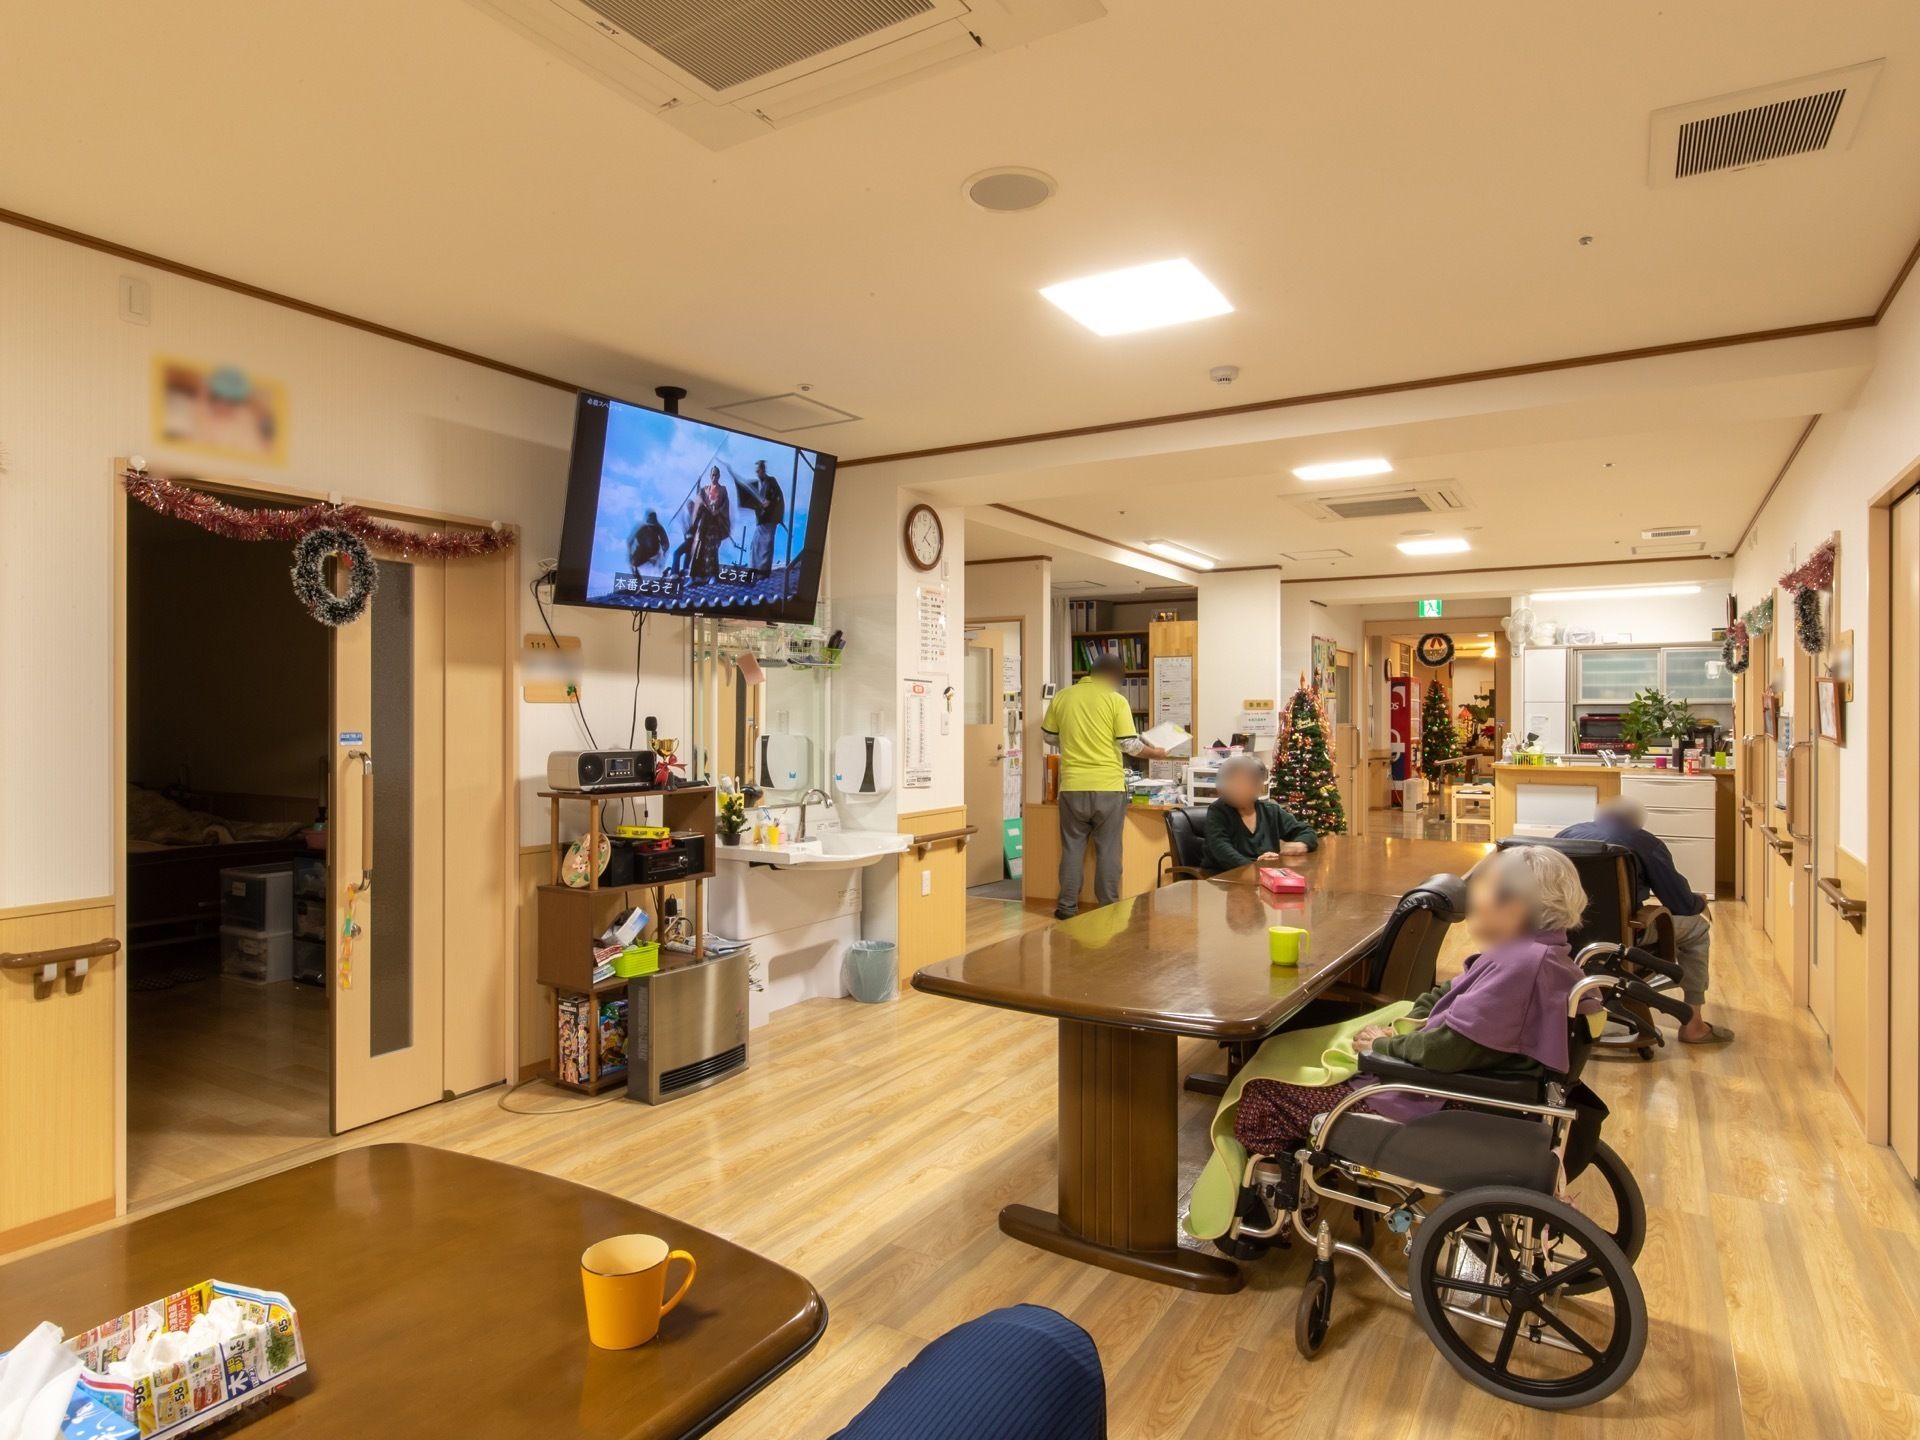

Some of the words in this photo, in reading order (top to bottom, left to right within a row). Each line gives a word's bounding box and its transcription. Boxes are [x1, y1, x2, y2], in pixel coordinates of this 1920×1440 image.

[718, 567, 755, 583] どうぞ！
[614, 576, 681, 595] 本番どうぞ！
[190, 1293, 200, 1313] OFF
[279, 1318, 289, 1333] 85
[227, 1369, 249, 1397] 木
[173, 1386, 185, 1402] 58
